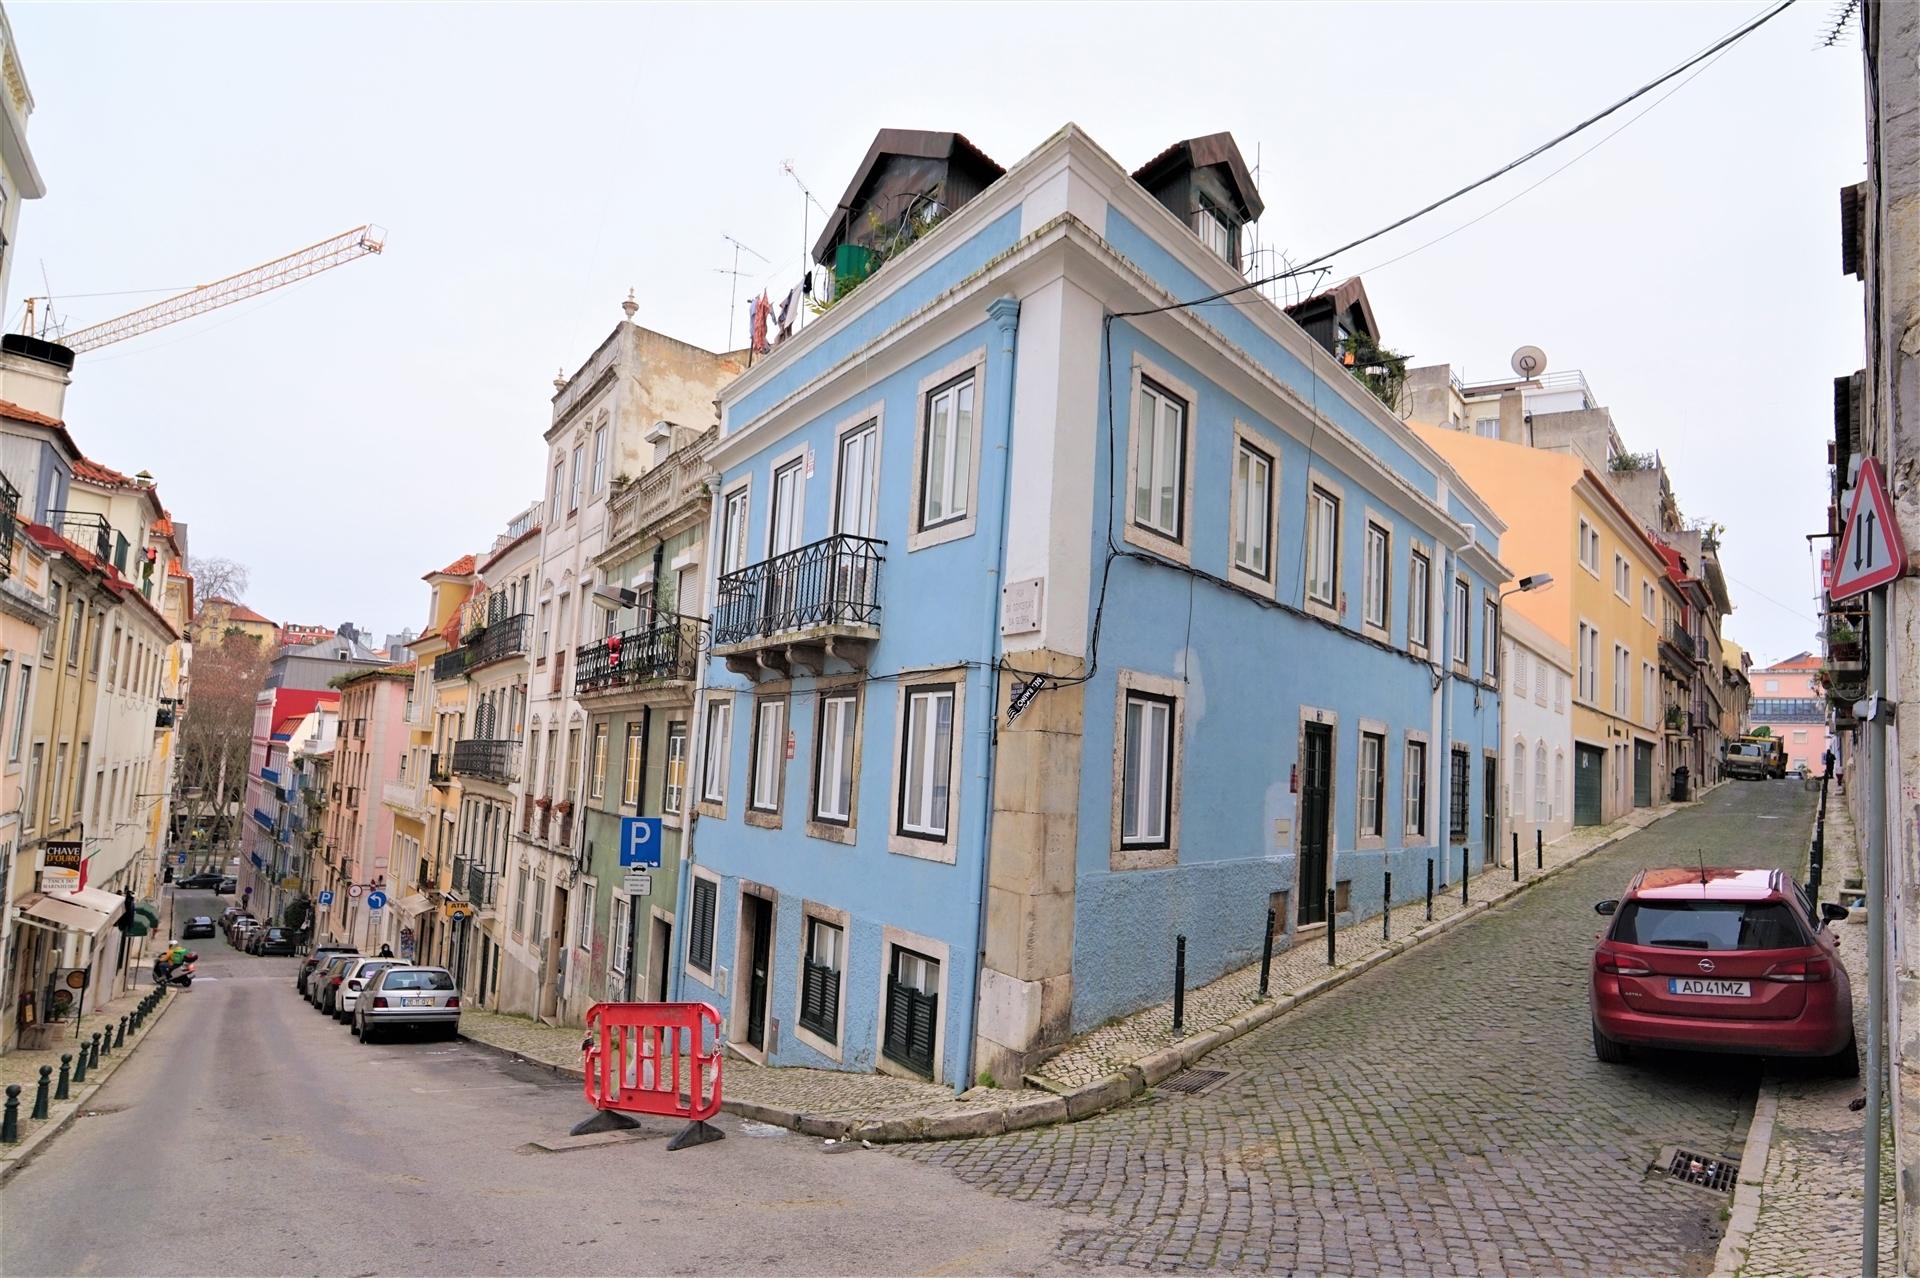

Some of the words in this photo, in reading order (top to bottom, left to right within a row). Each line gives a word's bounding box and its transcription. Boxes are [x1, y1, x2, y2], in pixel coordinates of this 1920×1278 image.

[1017, 677, 1043, 707] BELRMINO
[630, 821, 651, 856] P
[47, 847, 80, 855] CHAVE
[47, 854, 80, 862] D'OURO
[321, 892, 331, 903] P
